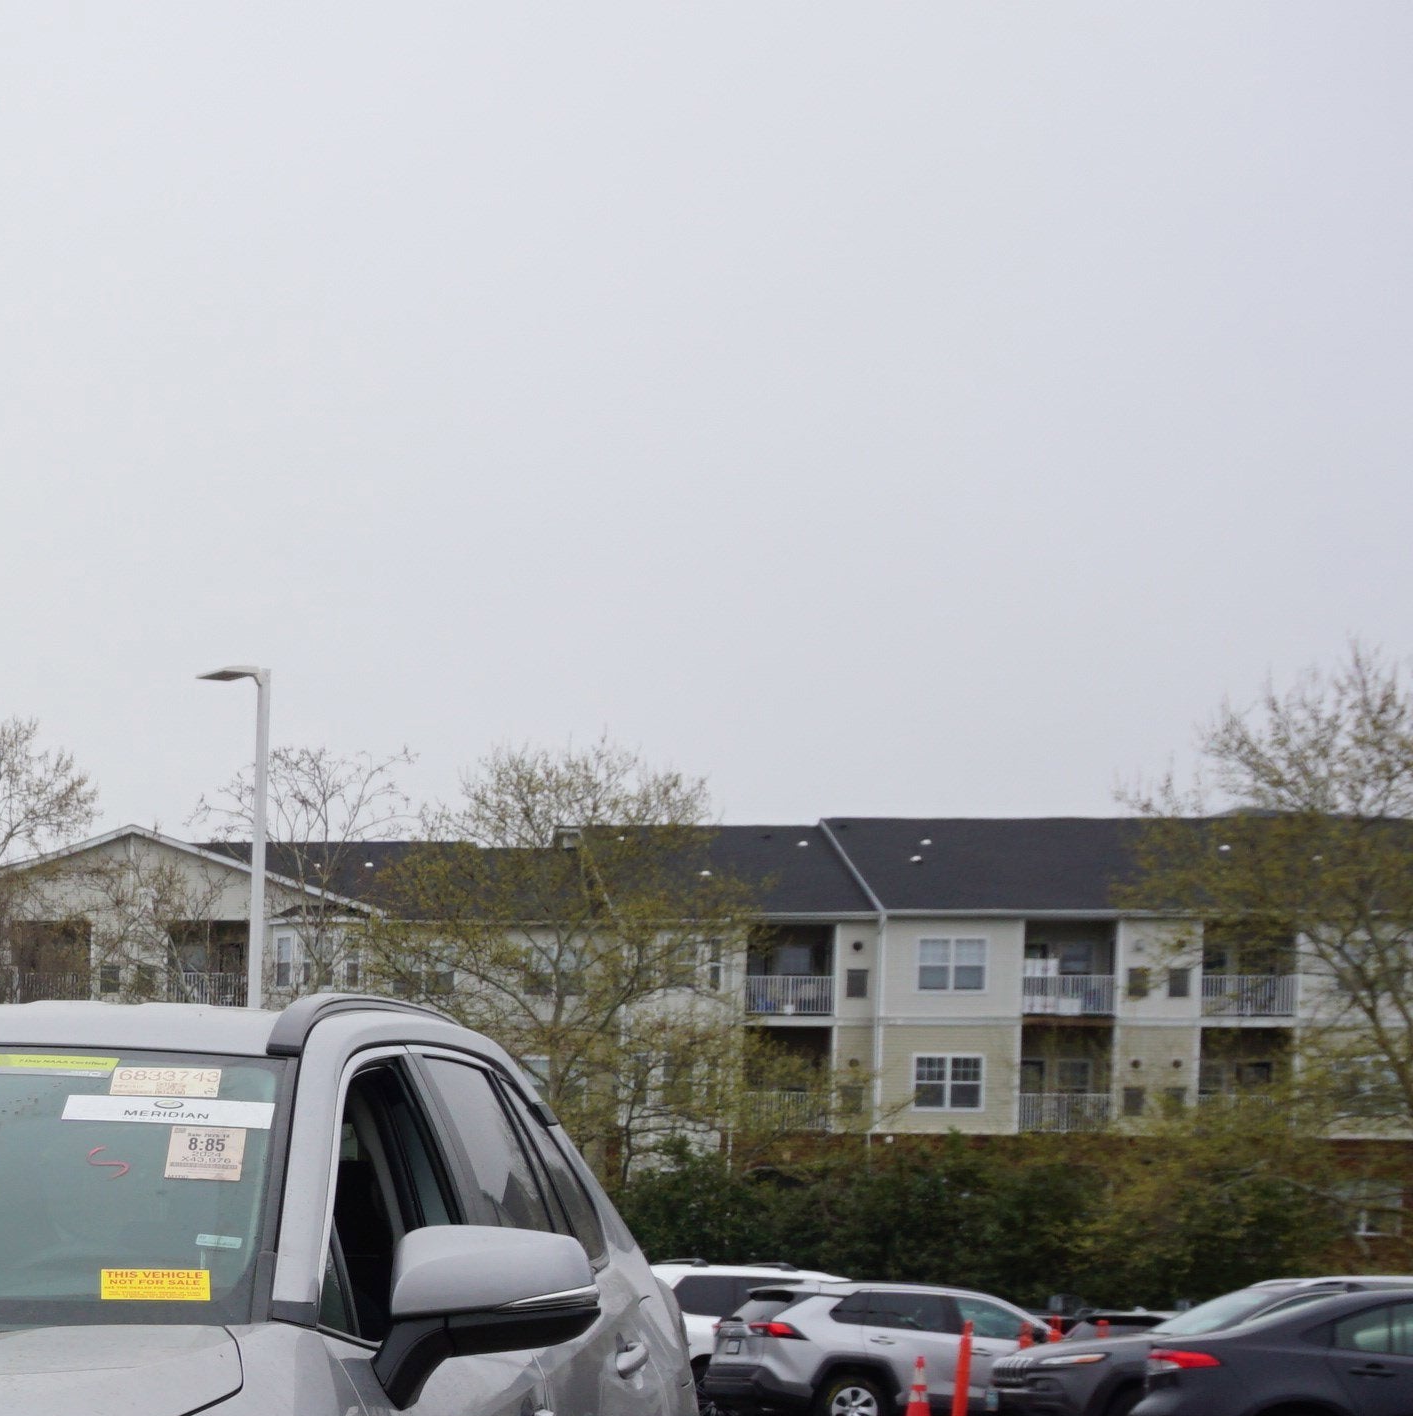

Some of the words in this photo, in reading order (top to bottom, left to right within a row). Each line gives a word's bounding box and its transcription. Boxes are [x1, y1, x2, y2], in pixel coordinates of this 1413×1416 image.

[123, 1109, 210, 1120] MERIDIAN
[188, 1137, 226, 1152] 8:85
[142, 1271, 203, 1279] VEHICLE
